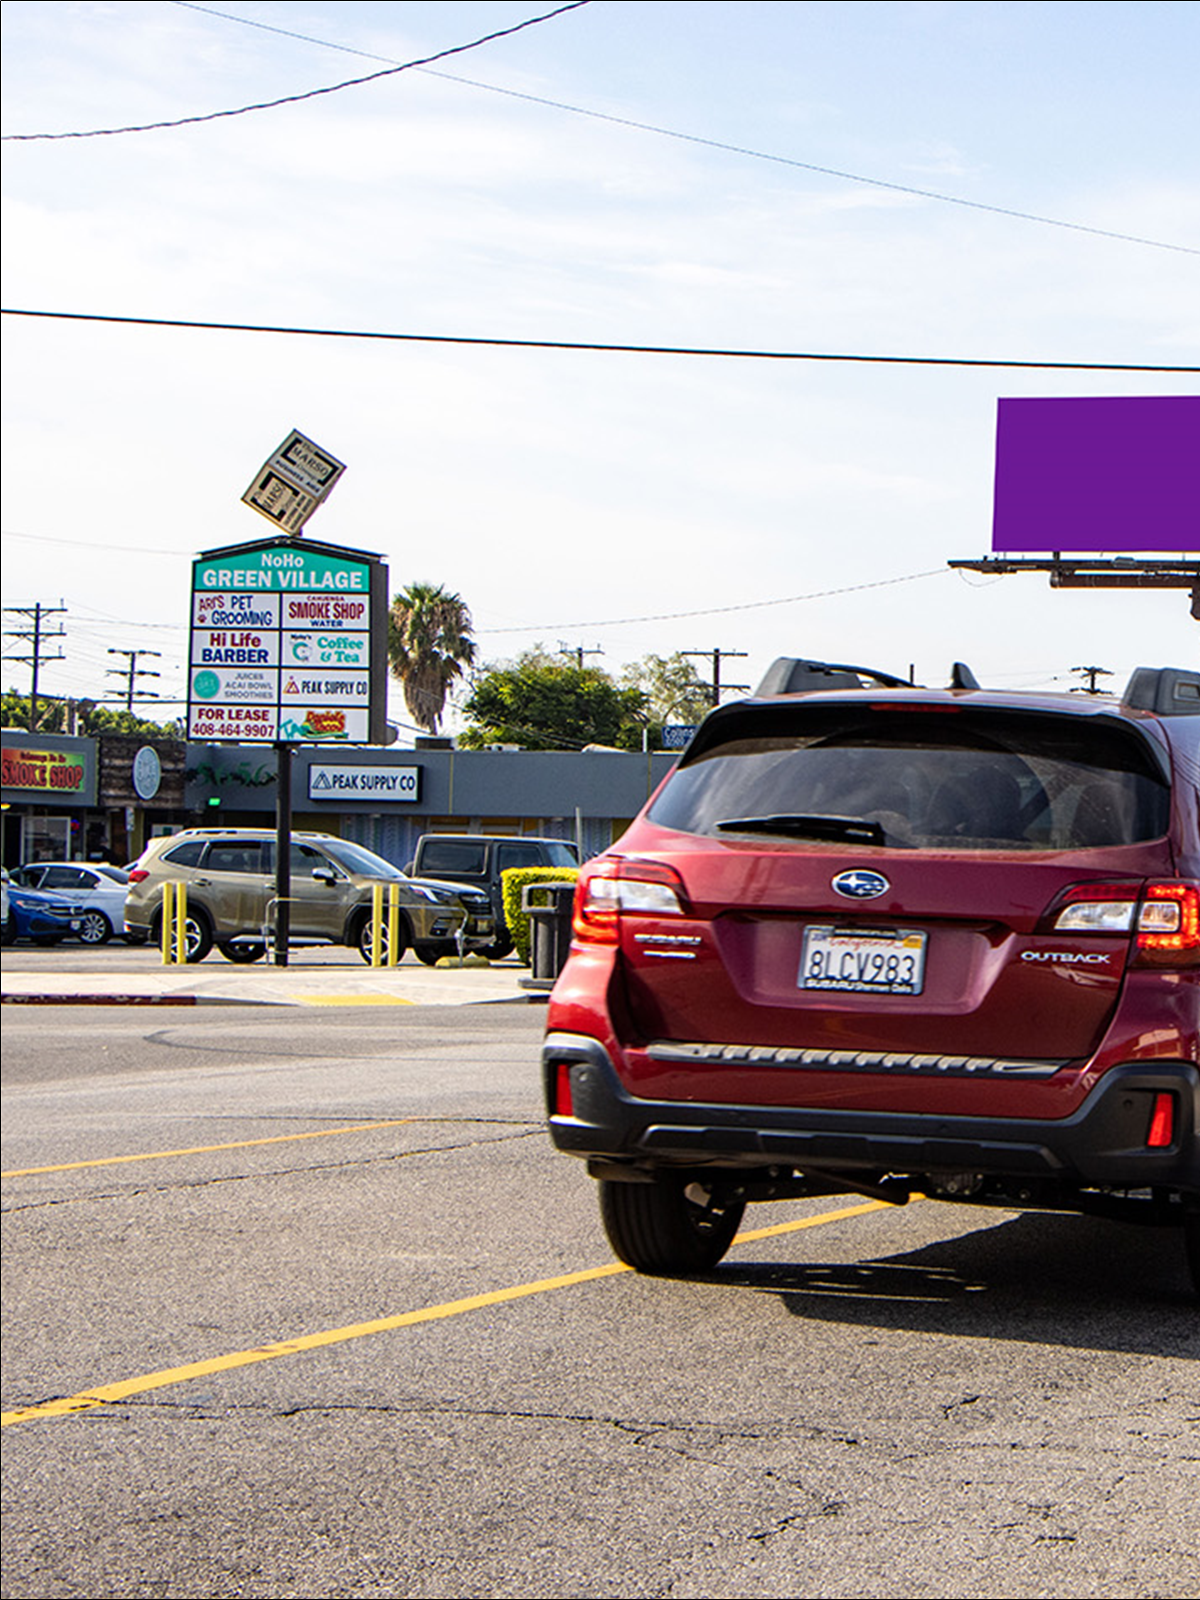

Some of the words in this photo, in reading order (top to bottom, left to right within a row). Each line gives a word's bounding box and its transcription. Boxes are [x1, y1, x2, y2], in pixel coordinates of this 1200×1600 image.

[291, 446, 329, 476] MARSO
[261, 553, 304, 568] NoHo
[203, 569, 272, 587] GREEN
[277, 570, 362, 588] VILLAGE
[231, 595, 254, 610] PET
[288, 601, 330, 619] SMOKE
[332, 602, 365, 619] SHOP
[211, 609, 273, 626] GROOMING
[310, 620, 344, 628] WATER
[210, 632, 227, 647] Hi
[230, 632, 262, 648] Life
[317, 636, 364, 650] Coffee
[202, 648, 269, 663] BARBER
[334, 650, 360, 663] Tea
[225, 691, 273, 699] SMOOTHIES
[301, 680, 323, 694] PEAK
[324, 680, 355, 695] SUPPLY
[356, 681, 367, 695] CO
[198, 708, 225, 720] FOR
[228, 709, 270, 721] LEASE
[192, 723, 275, 738] 408-464-9907
[2, 759, 47, 786] SMOKE
[50, 765, 83, 789] SHOP
[332, 774, 359, 789] PEAK
[360, 774, 399, 790] SUPPLY
[400, 775, 416, 791] CO
[1021, 951, 1111, 964] OUTBACK
[809, 950, 915, 983] 8LCV983
